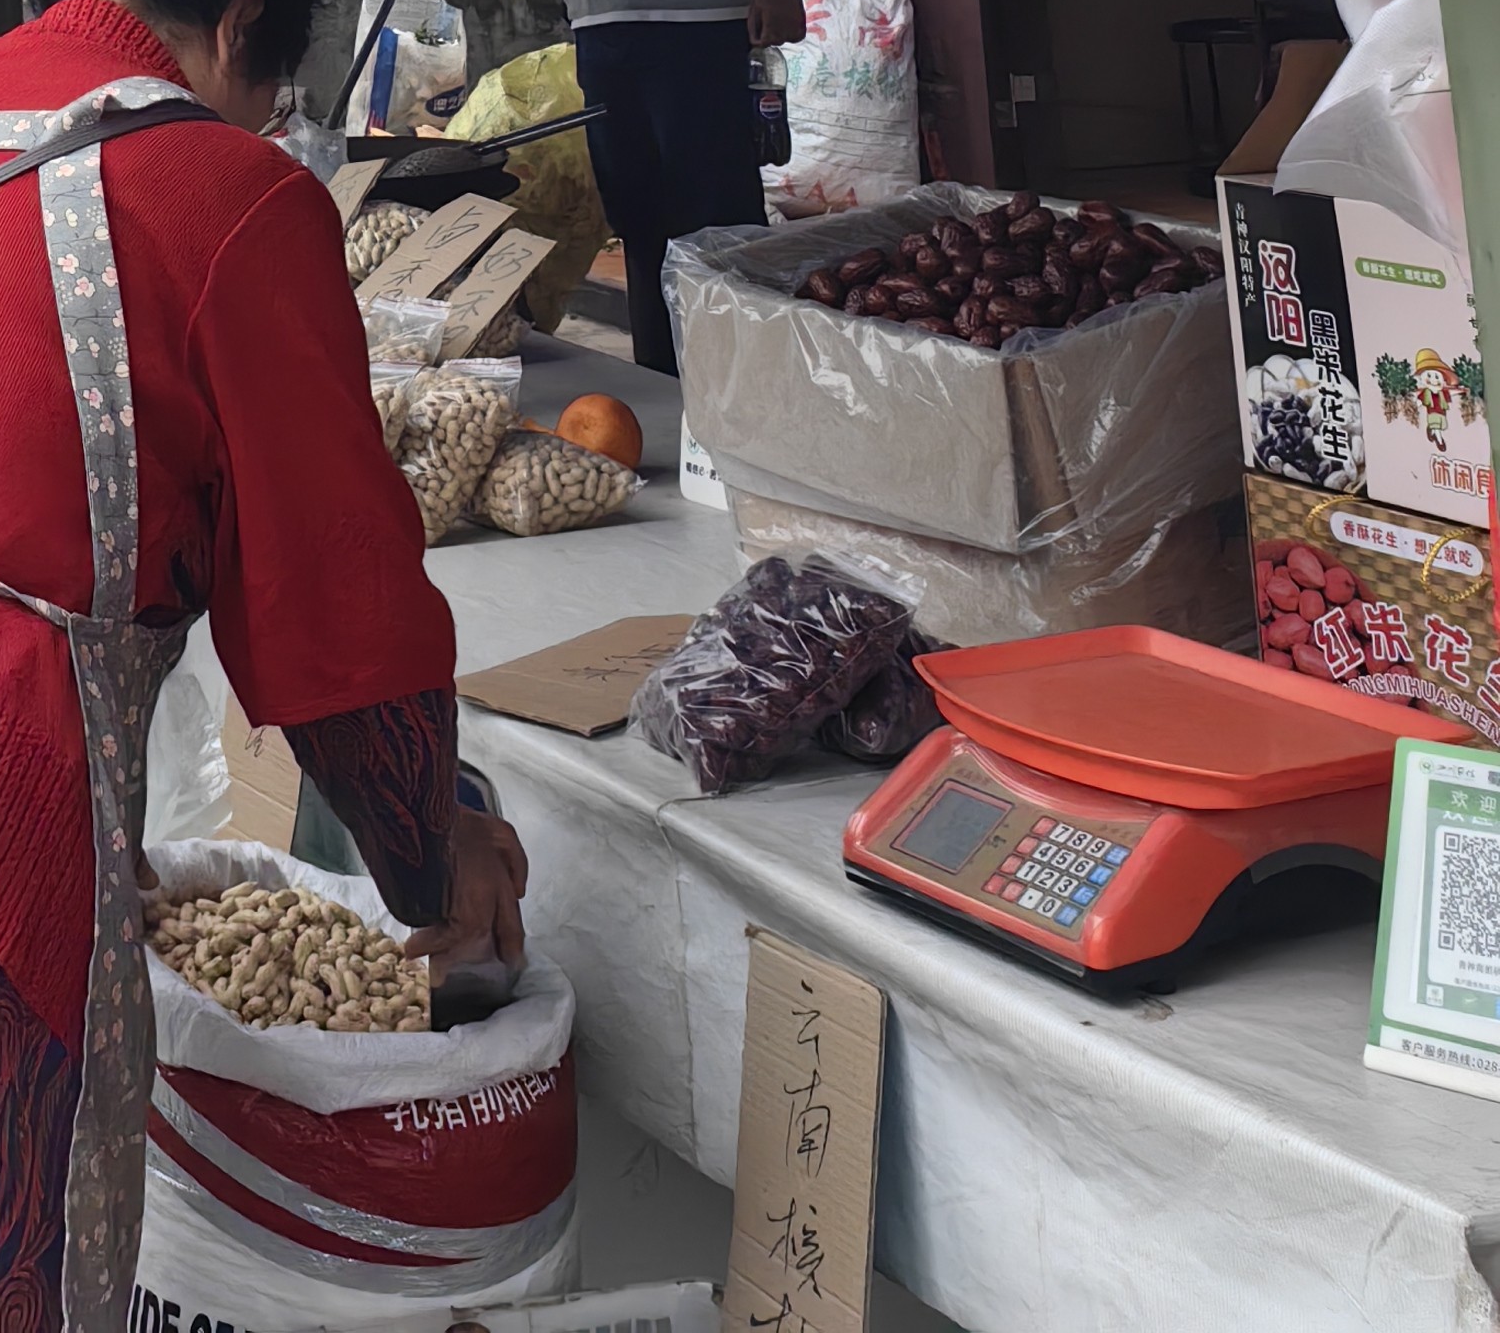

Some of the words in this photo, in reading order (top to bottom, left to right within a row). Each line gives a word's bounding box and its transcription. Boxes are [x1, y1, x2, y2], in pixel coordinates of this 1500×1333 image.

[1257, 239, 1307, 348] 汉阳
[1309, 309, 1349, 462] 黑米花生
[1342, 673, 1500, 746] ONGMIHUASHEN
[1449, 790, 1498, 817] 欢迎
